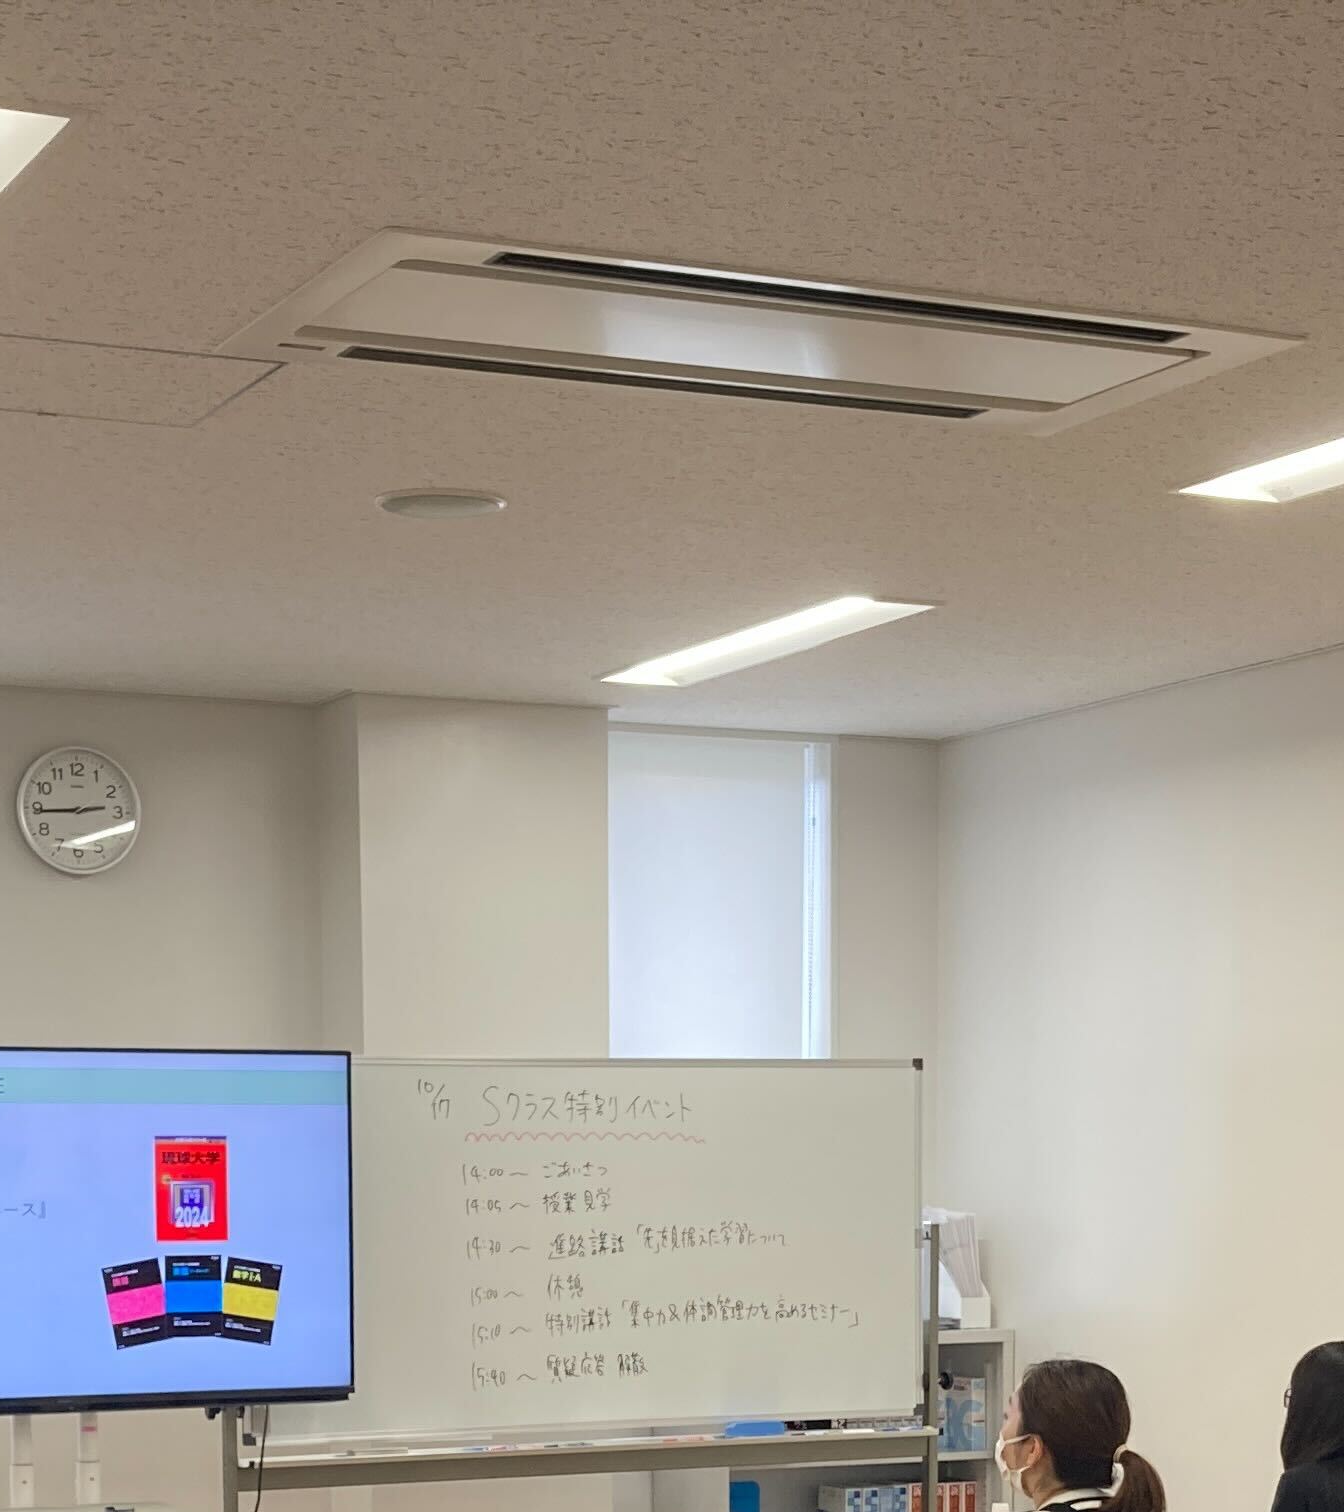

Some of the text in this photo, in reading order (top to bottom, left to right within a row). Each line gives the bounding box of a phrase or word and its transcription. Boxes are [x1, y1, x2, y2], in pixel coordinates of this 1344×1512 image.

[52, 768, 63, 780] 11
[69, 763, 84, 776] 12
[93, 770, 99, 783] 1
[37, 781, 52, 795] 10
[106, 785, 116, 798] 2
[32, 802, 42, 814] 9
[113, 806, 123, 819] 3
[39, 823, 49, 836] 8
[55, 838, 64, 852] 7
[175, 1205, 209, 1228] 2024
